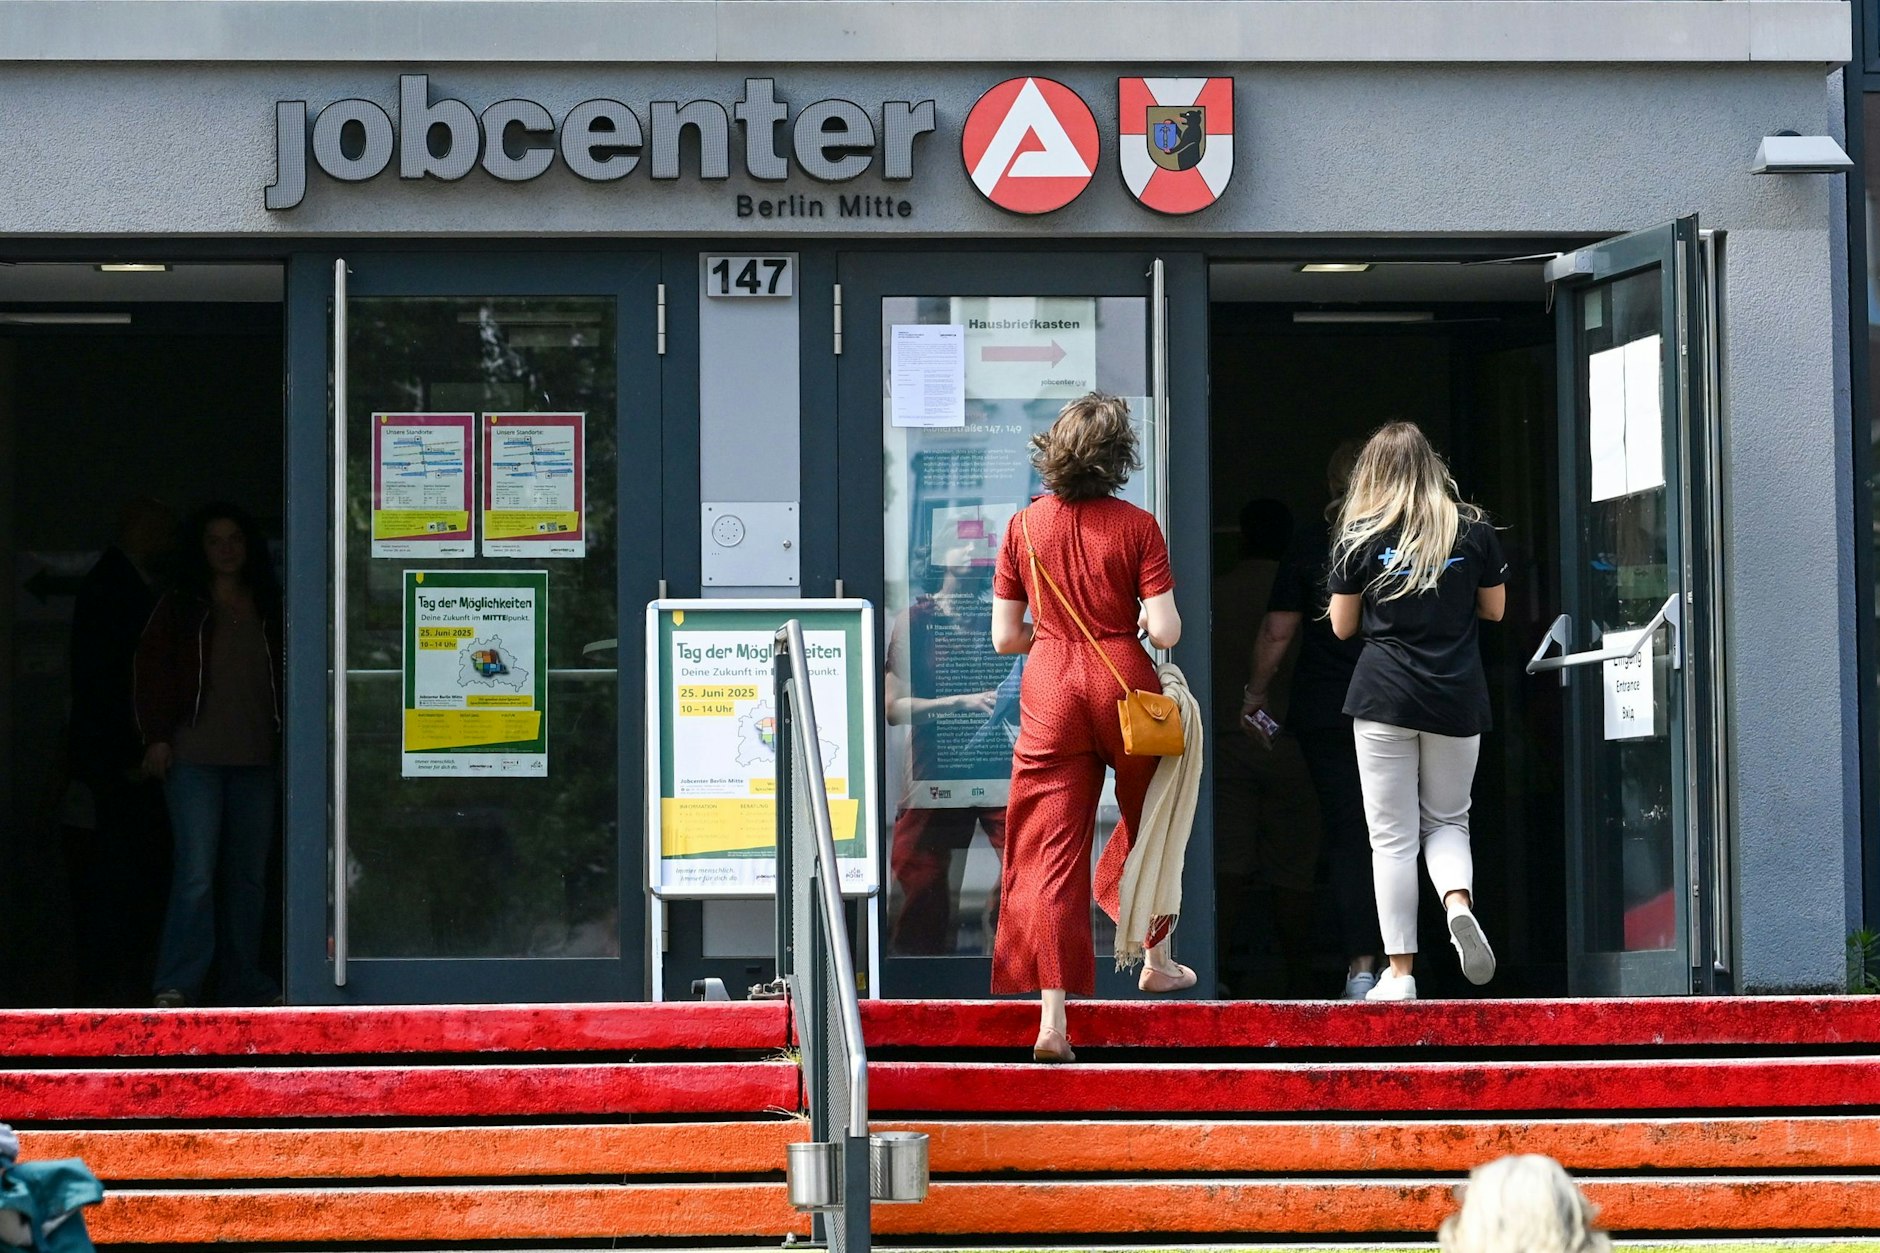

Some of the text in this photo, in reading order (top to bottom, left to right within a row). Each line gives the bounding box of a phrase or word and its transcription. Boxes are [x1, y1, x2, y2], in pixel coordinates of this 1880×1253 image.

[265, 74, 936, 212] jobcenter
[737, 194, 913, 218] Berlin Mitte
[712, 259, 789, 294] 147
[968, 318, 1080, 330] Hausbriefkasten
[418, 595, 532, 611] Tag der Möglichkeiten
[676, 642, 842, 663] Tag der Mögleiten
[681, 667, 710, 677] Deine
[713, 667, 752, 677] Zukunft
[755, 667, 767, 676] im
[680, 688, 755, 698] 25. Juni 2025
[1616, 680, 1641, 693] Entrance
[681, 704, 693, 714] 10
[702, 704, 713, 714] 14
[715, 704, 733, 714] Uhr
